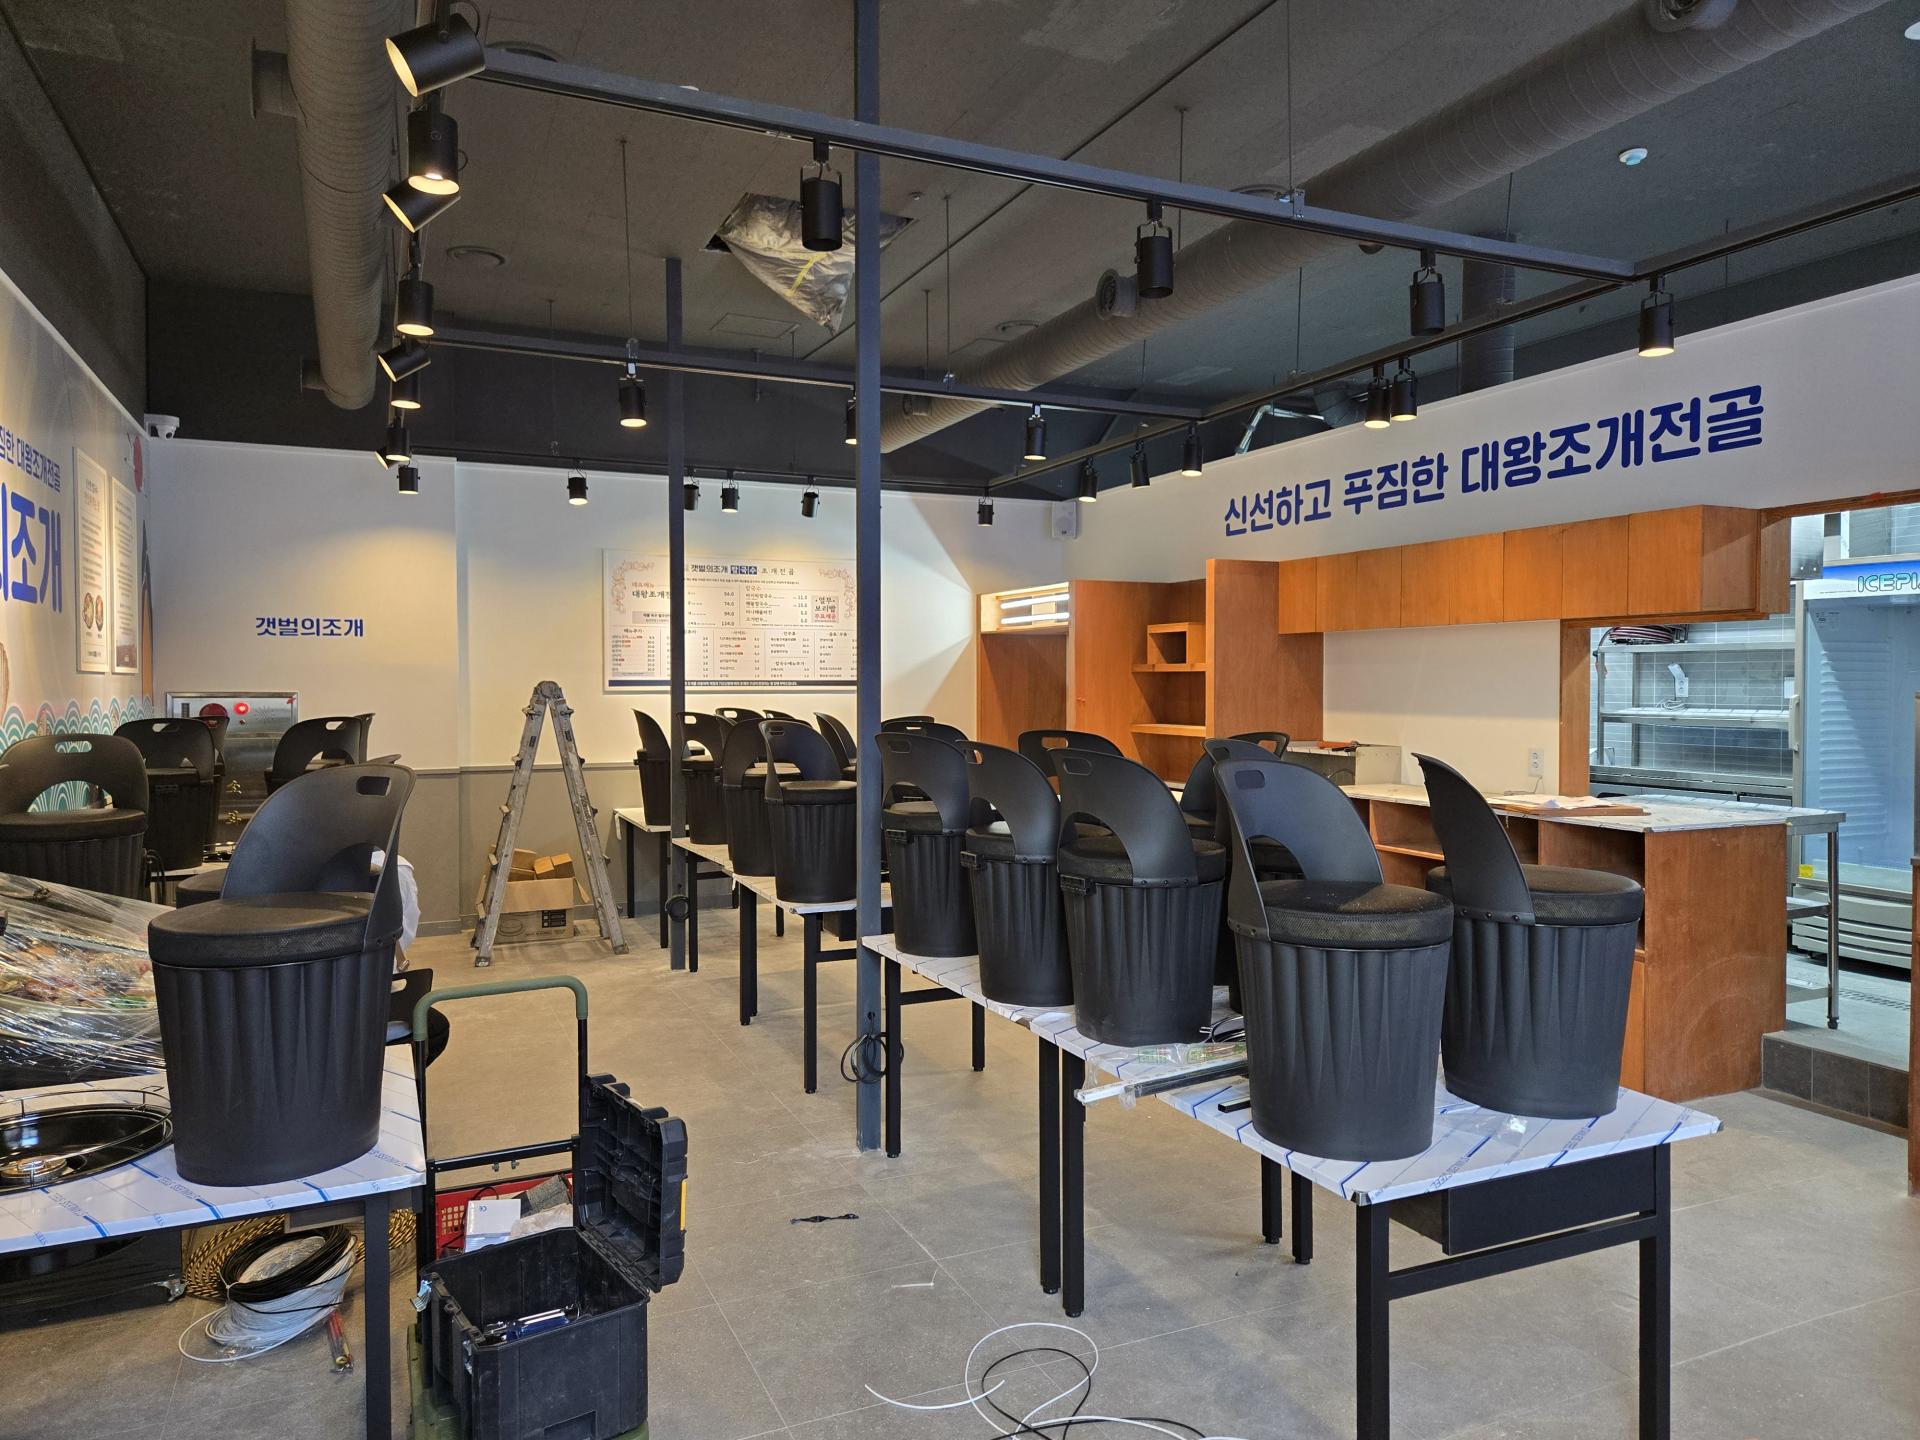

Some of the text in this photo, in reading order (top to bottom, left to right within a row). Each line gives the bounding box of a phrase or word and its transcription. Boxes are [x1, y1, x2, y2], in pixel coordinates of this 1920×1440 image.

[17, 437, 61, 493] 대왕조개전골
[1224, 384, 1764, 537] 신선하고 푸짐한 대왕조개전골
[691, 564, 729, 573] 갯벌의조개
[1857, 571, 1920, 593] ICEPI
[255, 616, 364, 638] 갯벌의조개
